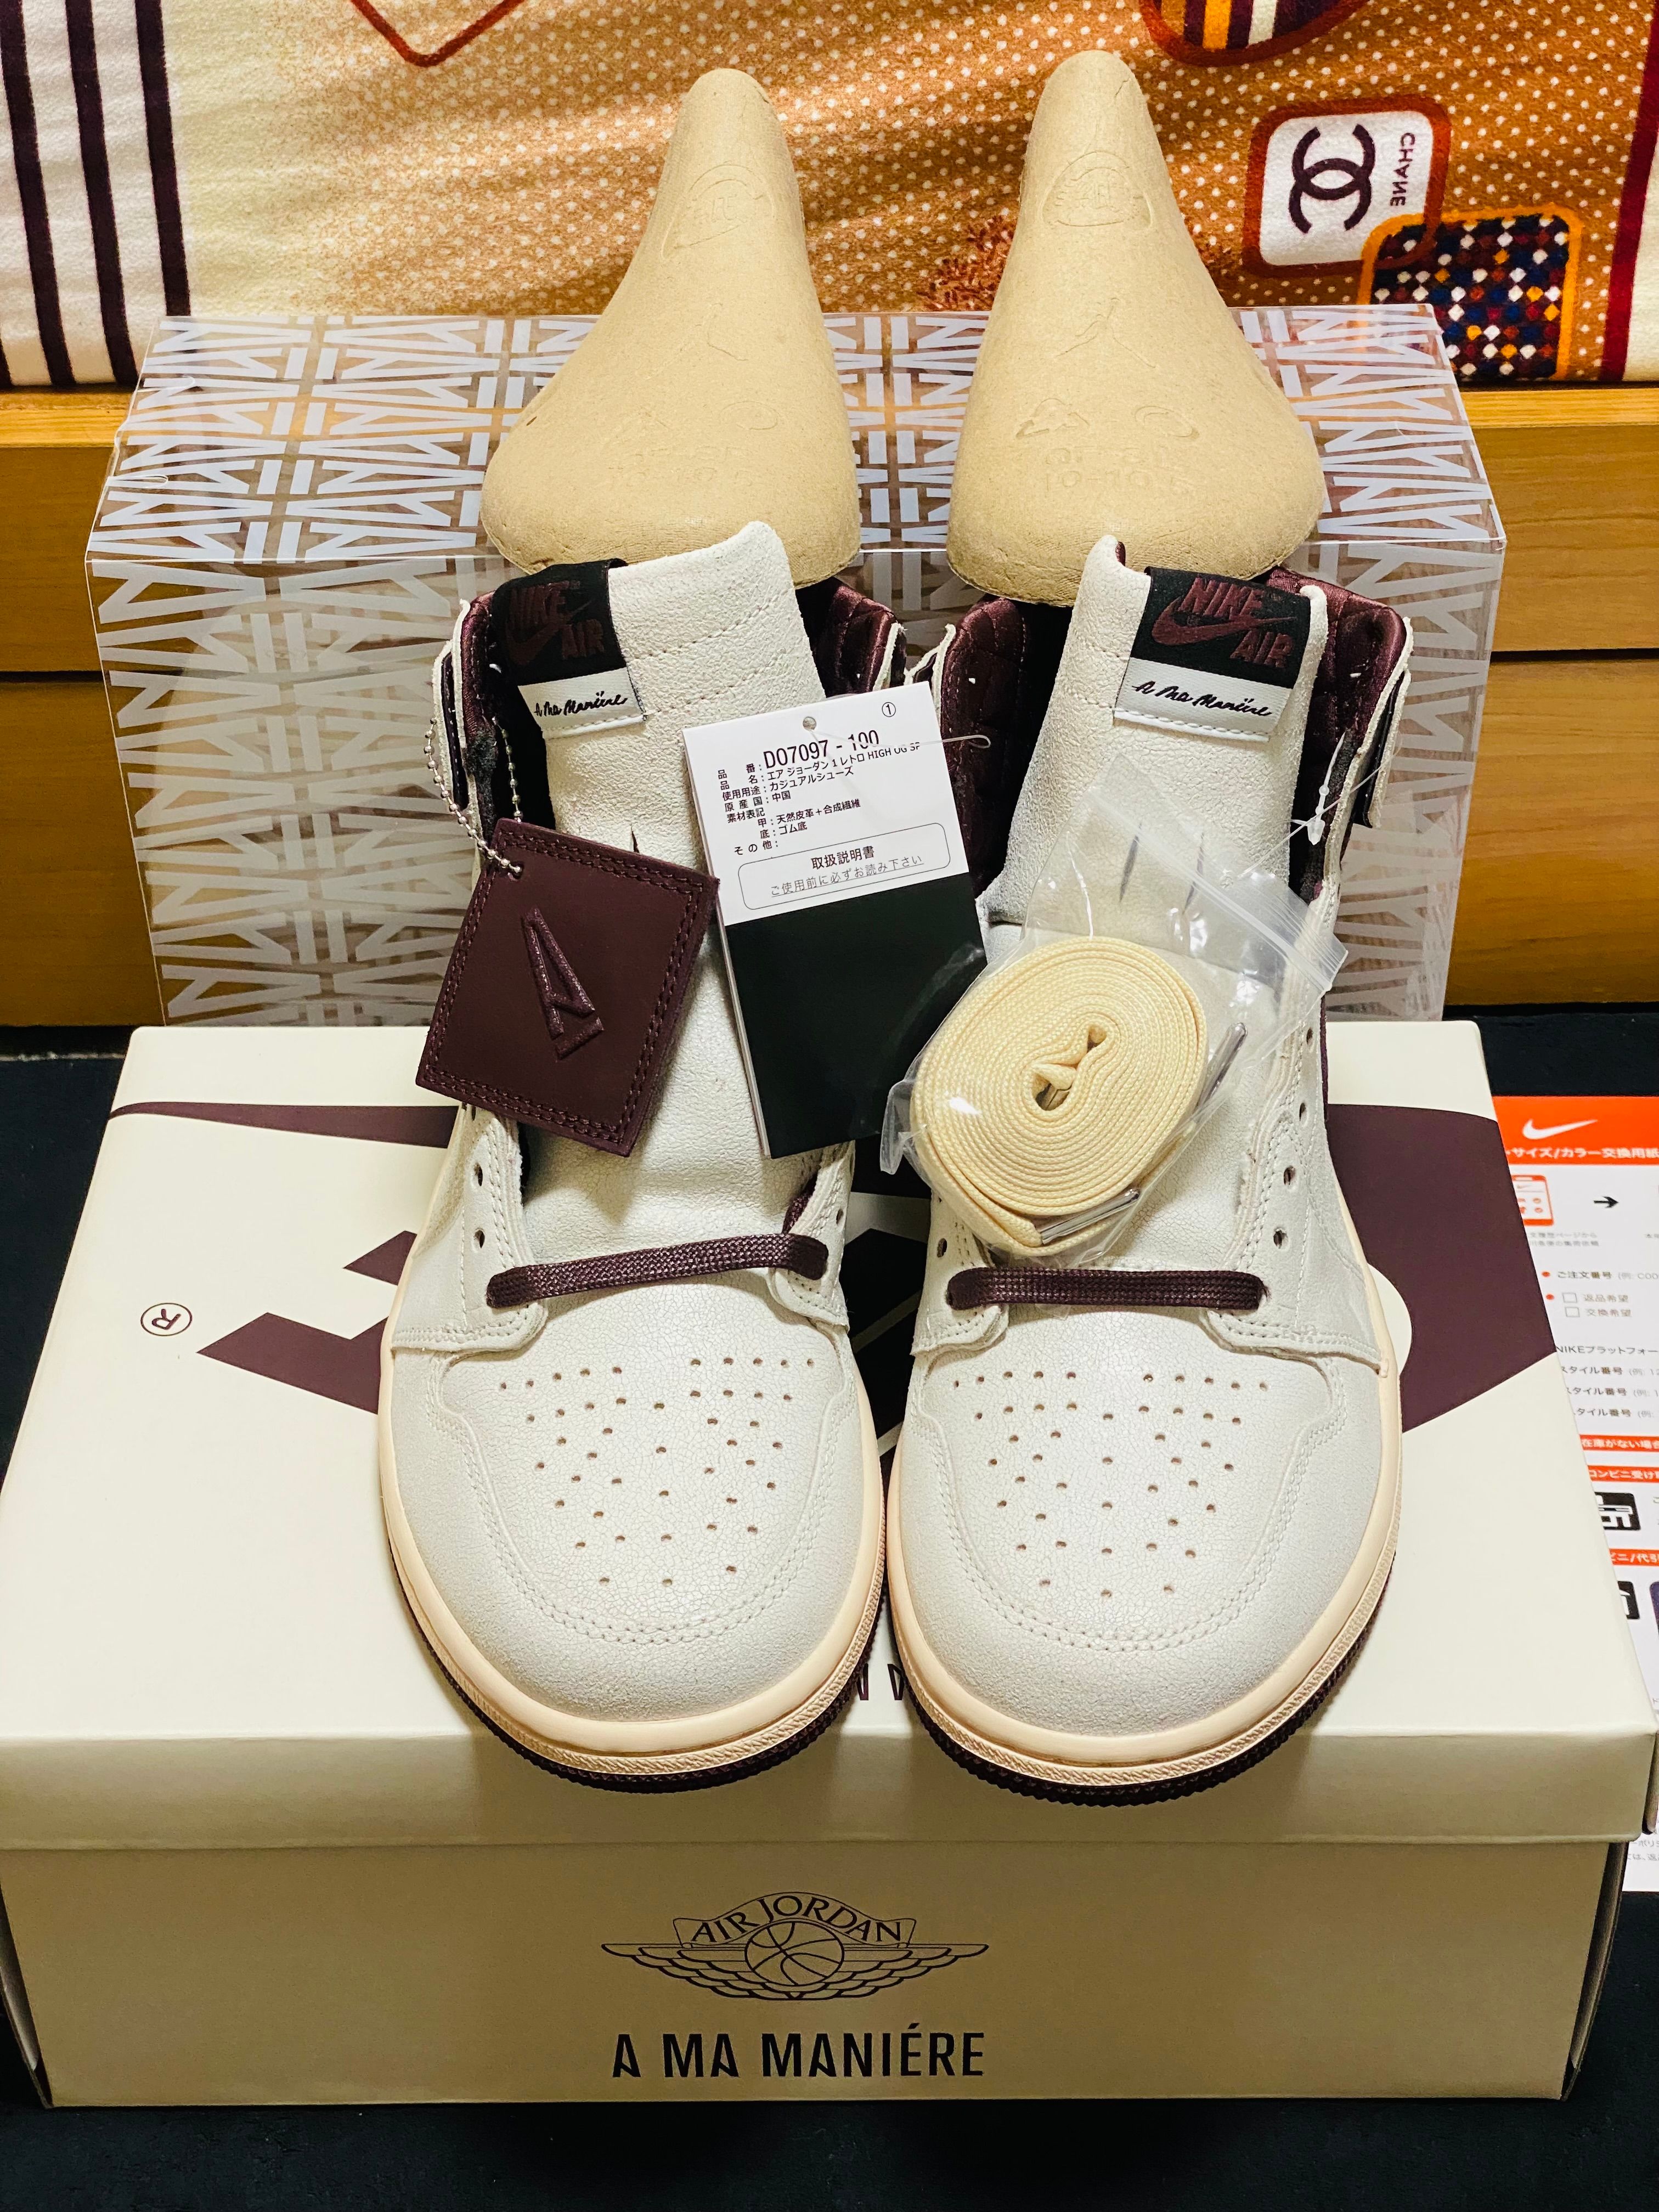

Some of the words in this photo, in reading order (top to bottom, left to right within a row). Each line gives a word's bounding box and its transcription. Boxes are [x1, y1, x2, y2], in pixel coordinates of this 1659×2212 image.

[1178, 575, 1265, 620] NIKE
[561, 619, 605, 659] AIR
[1230, 629, 1295, 668] AIR
[840, 754, 865, 765] レトロ
[867, 748, 891, 760] HIGH
[848, 730, 879, 751] 100
[726, 808, 765, 823] 素材表記
[770, 855, 923, 895] ご使用前に必ずお読み下さい
[811, 845, 875, 870] 取扱説明書
[1574, 1408, 1631, 1418] タイル番号
[691, 1911, 759, 1945] AIR
[755, 1894, 902, 1943] JORDAN
[612, 2033, 642, 2078] A
[663, 2033, 740, 2078] MA
[761, 2022, 985, 2077] MANIÉRE
